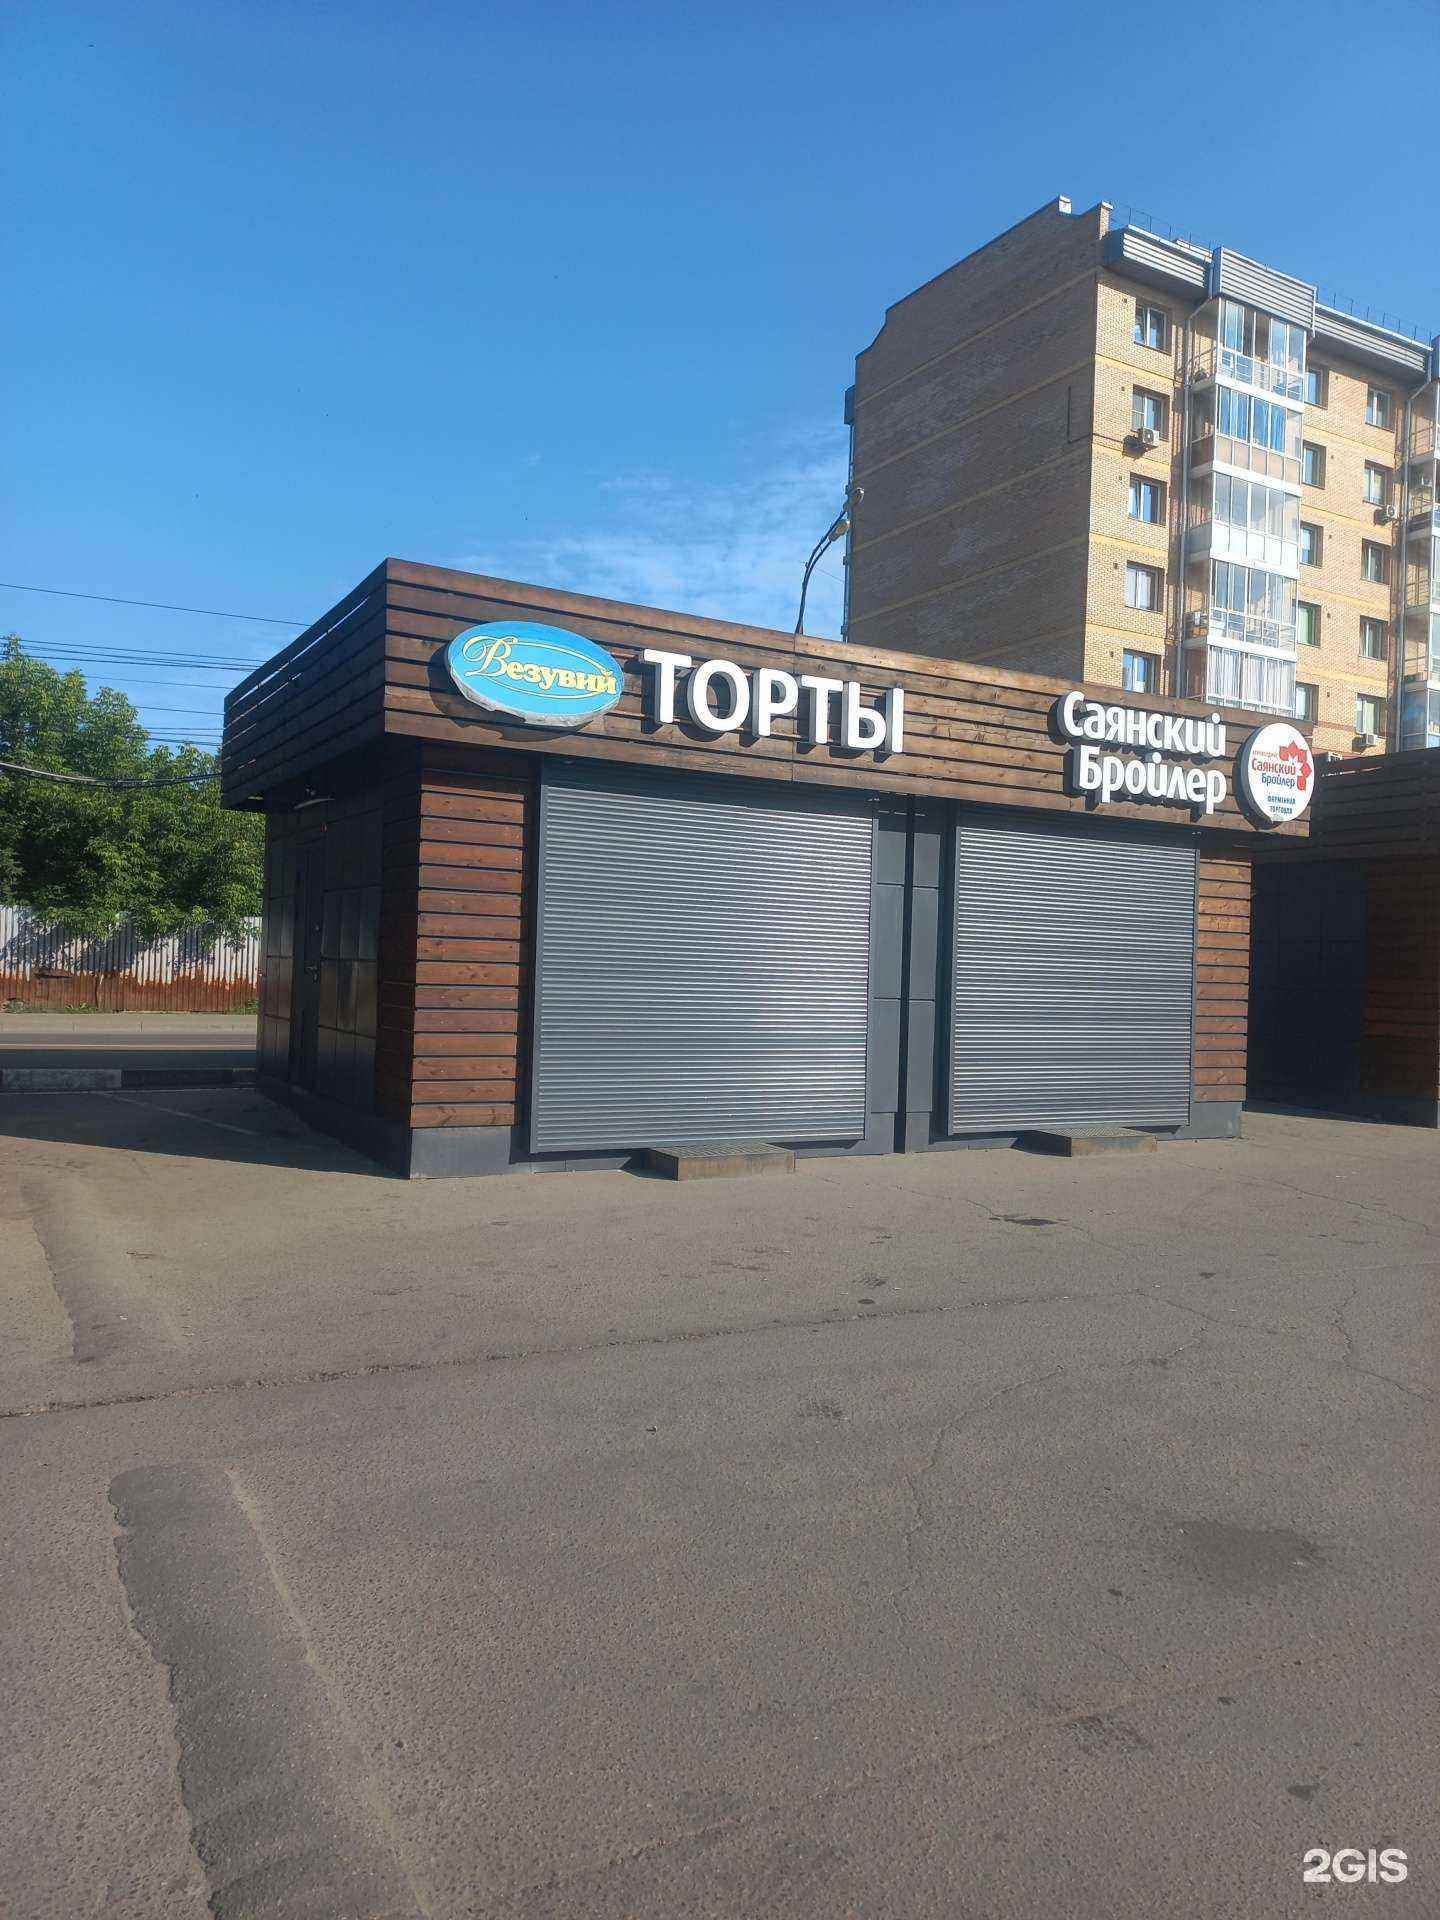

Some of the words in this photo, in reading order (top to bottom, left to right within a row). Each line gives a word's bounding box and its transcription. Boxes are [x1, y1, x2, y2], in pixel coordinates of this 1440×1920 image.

[463, 635, 618, 695] Везувий
[642, 648, 905, 754] ТОРТЫ
[1062, 691, 1226, 757] Саянский
[1079, 745, 1227, 814] Бройлер
[1251, 758, 1296, 775] Саянский
[1262, 772, 1296, 789] Бройлер
